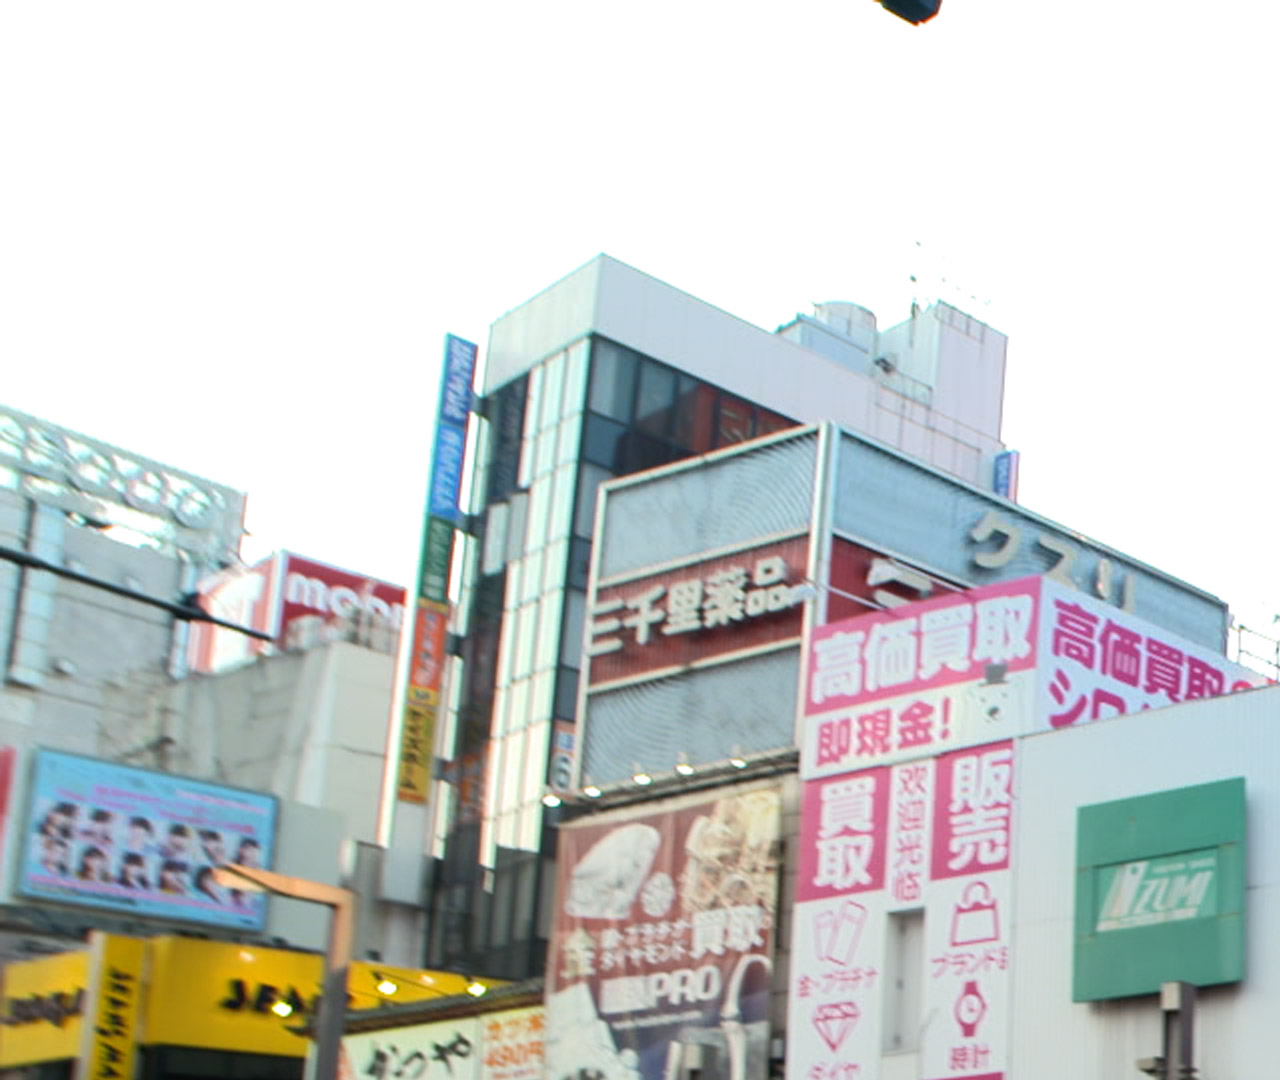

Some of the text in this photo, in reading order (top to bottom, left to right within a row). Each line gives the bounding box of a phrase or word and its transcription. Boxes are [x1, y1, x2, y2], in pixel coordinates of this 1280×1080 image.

[812, 594, 1032, 702] 高価買取
[1052, 598, 1225, 702] 高価買取
[815, 697, 952, 768] 即現金!
[812, 775, 878, 890] 買取
[947, 748, 1013, 871] 販売
